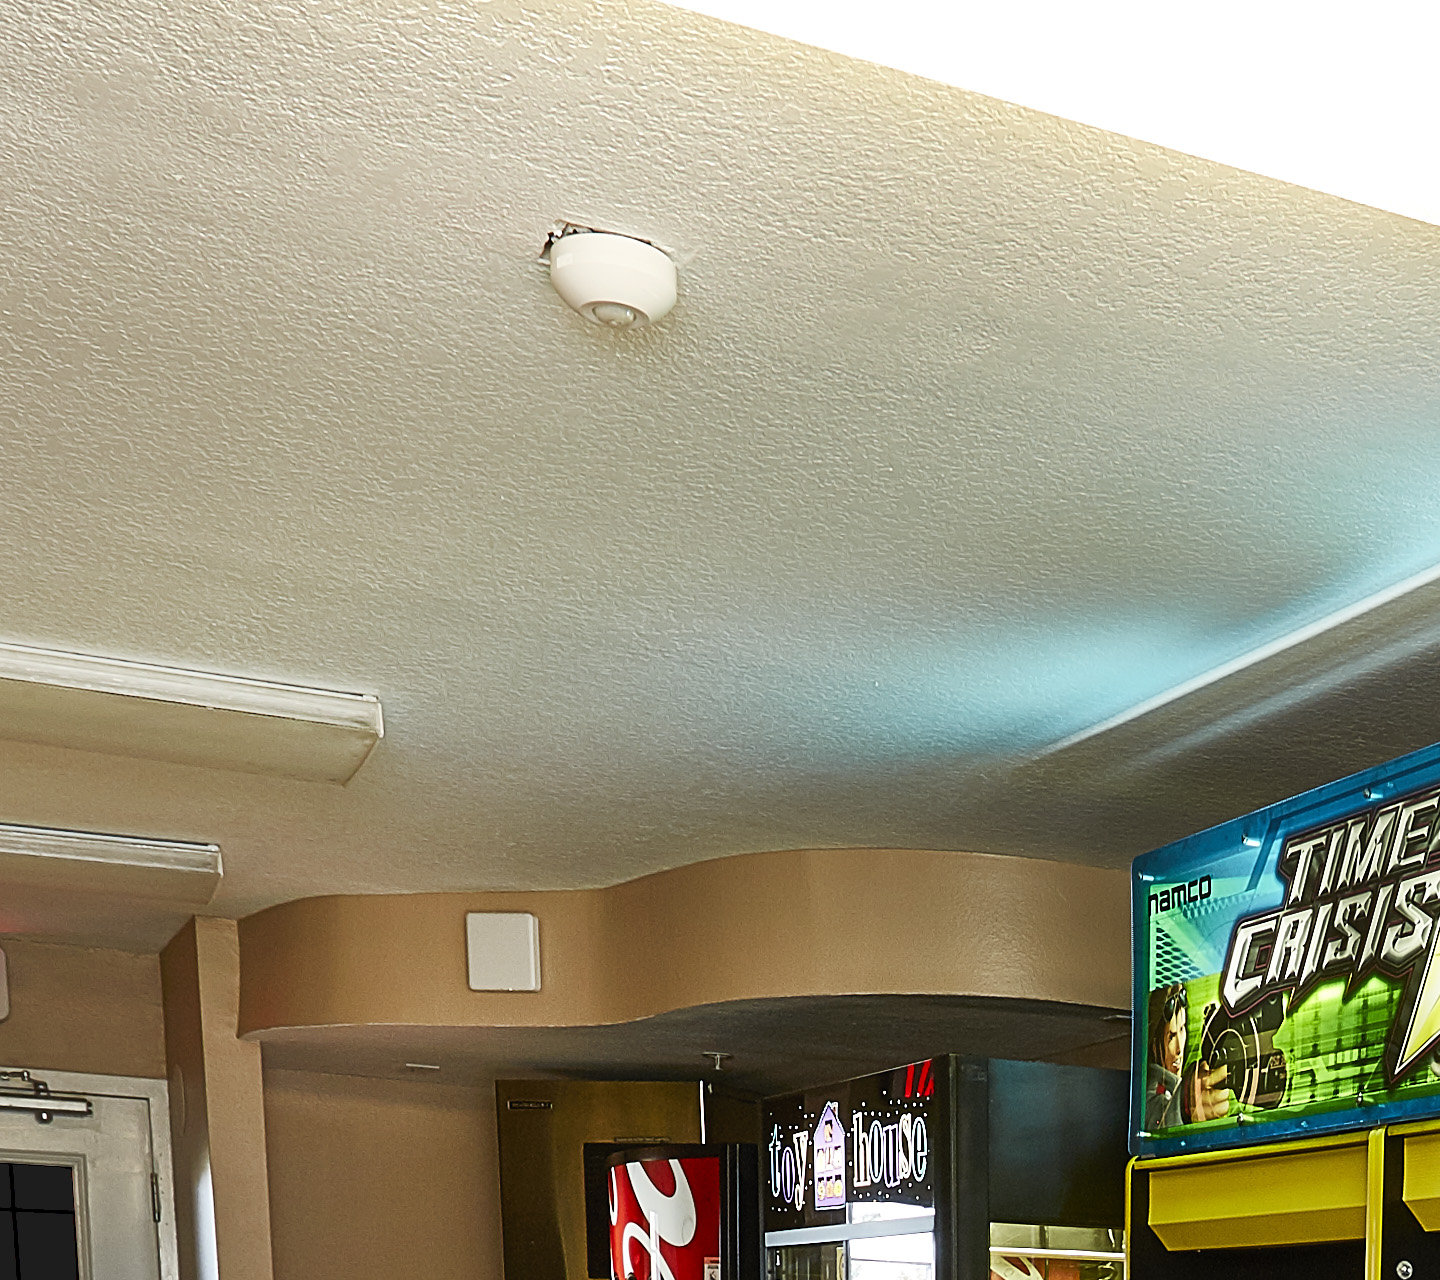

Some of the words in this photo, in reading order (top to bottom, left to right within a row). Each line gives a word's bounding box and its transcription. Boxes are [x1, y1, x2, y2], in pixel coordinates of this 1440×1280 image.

[1148, 874, 1212, 917] namco
[1285, 799, 1439, 904] TIME
[768, 1123, 809, 1211] toy
[852, 1111, 928, 1188] house
